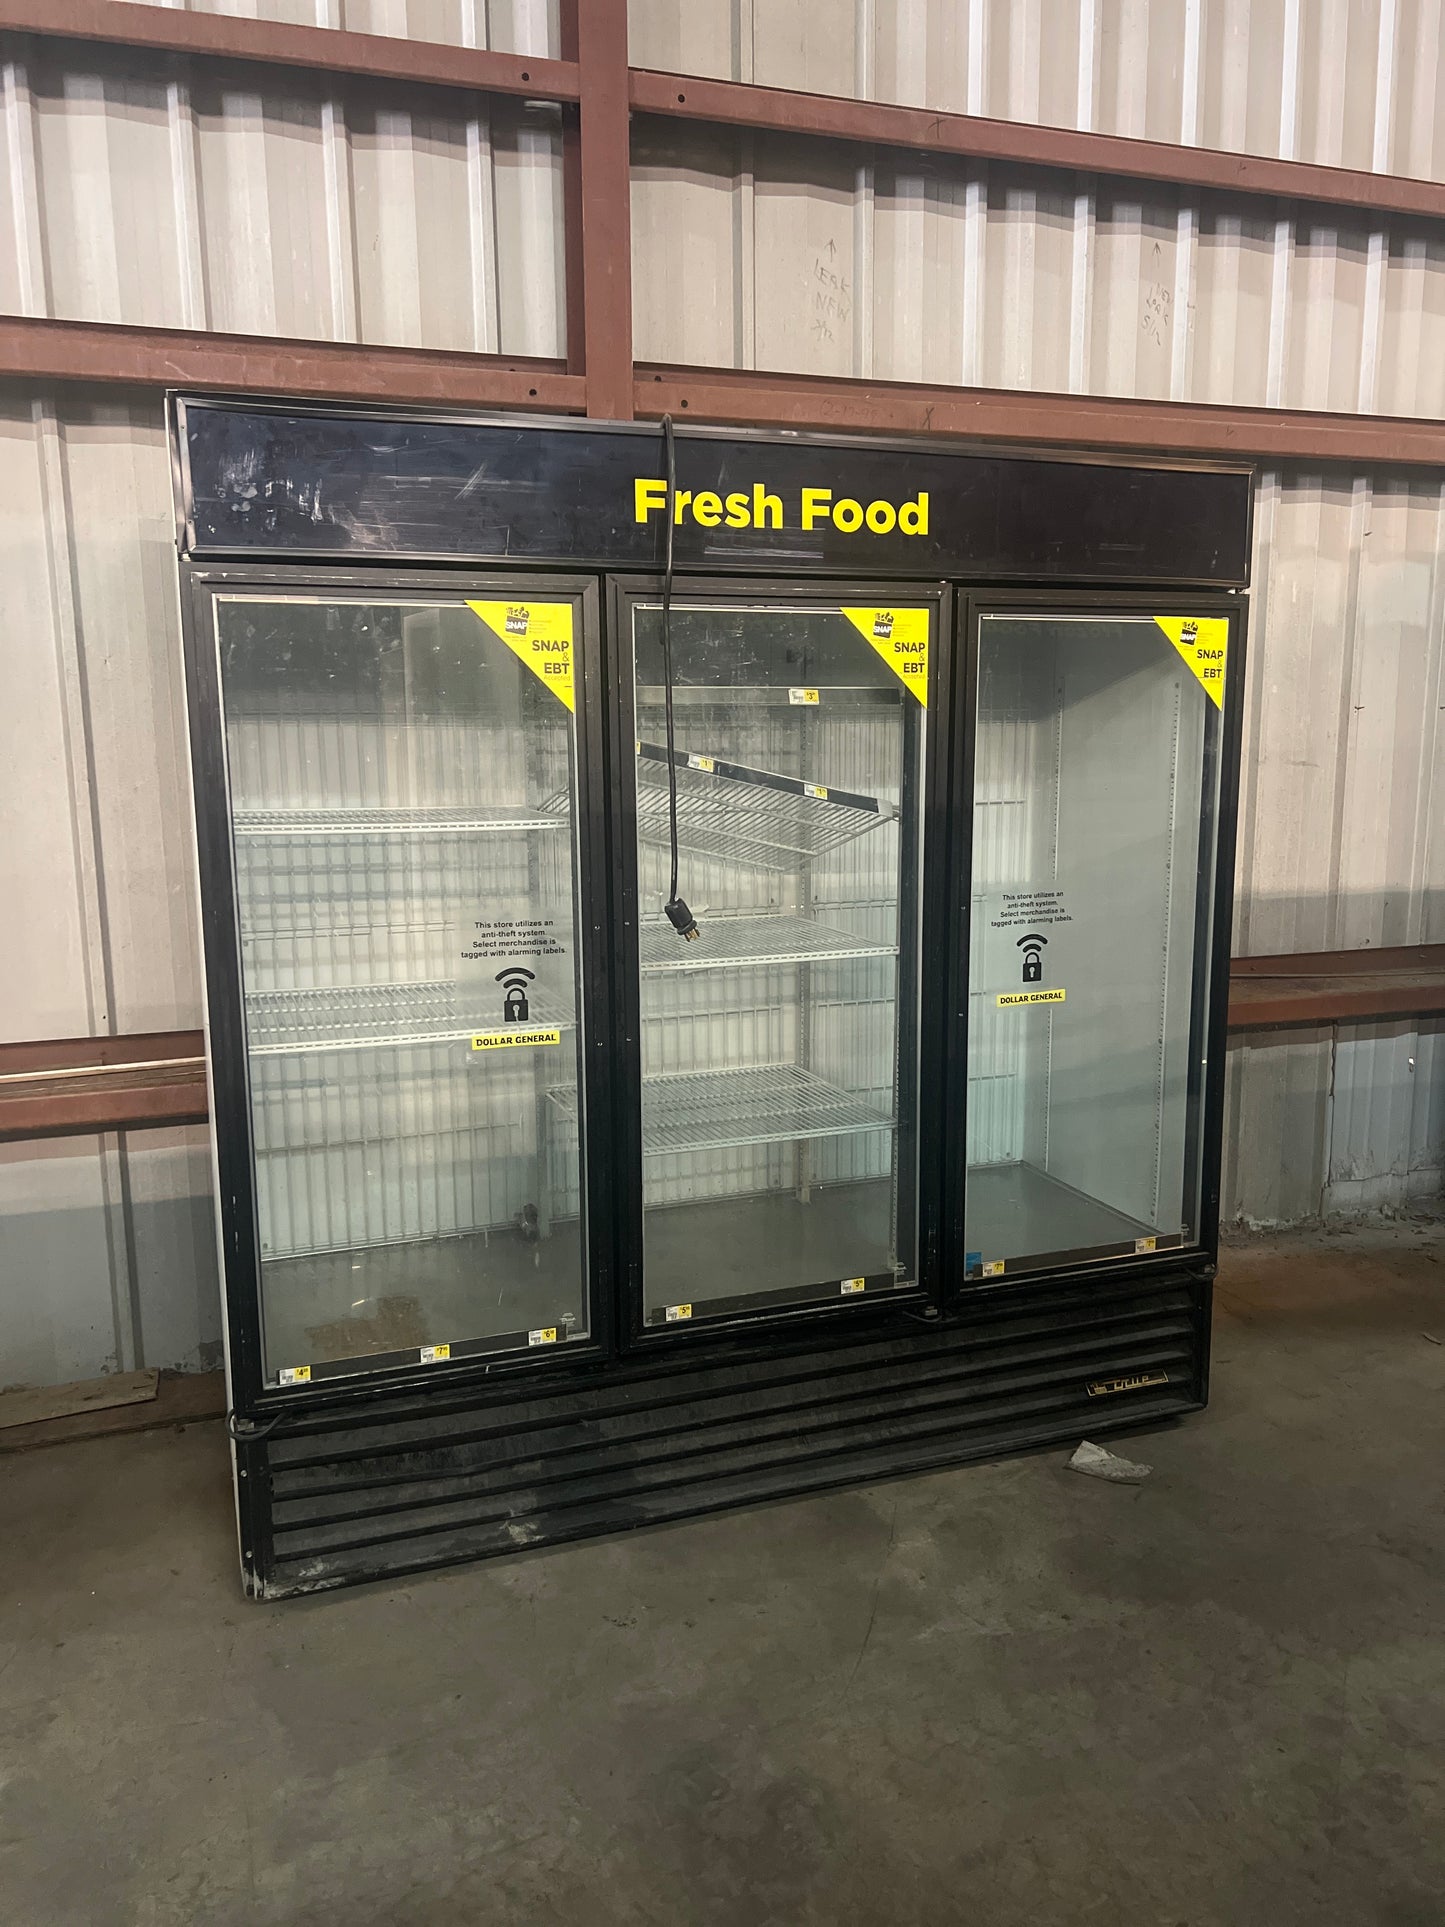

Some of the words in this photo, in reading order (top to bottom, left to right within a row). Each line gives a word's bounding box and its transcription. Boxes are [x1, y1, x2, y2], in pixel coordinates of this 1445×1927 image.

[634, 478, 784, 529] Fresh
[802, 488, 929, 536] Food
[505, 621, 528, 630] SNAP
[873, 625, 892, 634] SNAP
[532, 640, 569, 652] SNAP
[894, 642, 925, 653] SNAP
[562, 652, 570, 662] &
[1197, 649, 1223, 659] SNAP
[544, 663, 570, 674] EBT
[903, 663, 925, 673] EBT
[1204, 668, 1222, 678] EBT
[991, 920, 1012, 928] tagged
[481, 930, 516, 938] anti-theft
[499, 939, 547, 947] merchandise
[461, 951, 488, 959] tagged
[508, 948, 541, 956] alarming
[1000, 995, 1029, 1004] DOLLAR
[1030, 992, 1062, 1001] GENERAL
[476, 1036, 513, 1046] DOLLAR
[515, 1034, 556, 1043] GENERAL
